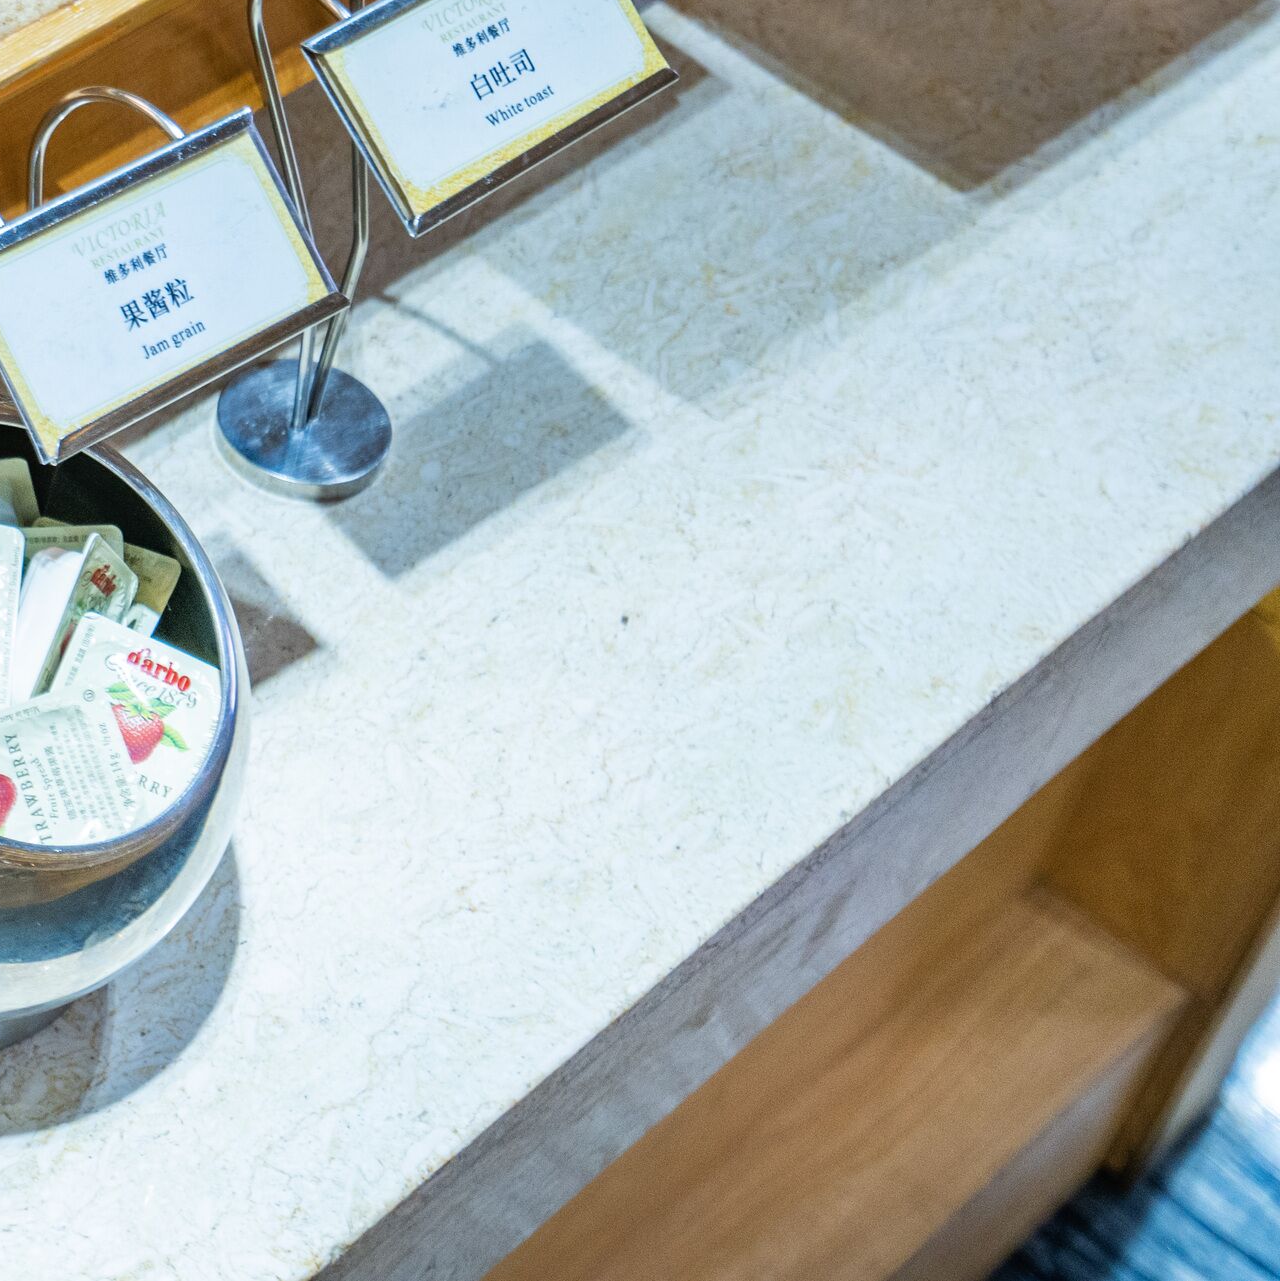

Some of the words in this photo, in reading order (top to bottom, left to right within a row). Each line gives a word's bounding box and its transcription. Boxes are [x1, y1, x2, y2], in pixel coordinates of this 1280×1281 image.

[440, 3, 507, 43] RESTAURANT
[453, 18, 509, 56] 维多利餐厅
[471, 49, 535, 100] 白吐司
[486, 103, 523, 125] White
[524, 86, 553, 107] toast
[71, 201, 168, 258] VICTORIA
[92, 227, 167, 267] RESTAURANT
[104, 244, 166, 284] 维多利餐厅
[121, 279, 194, 328] 果酱粒
[143, 340, 169, 359] Jam
[172, 322, 205, 348] grain
[158, 679, 200, 715] 1879
[29, 755, 53, 792] Spread
[43, 792, 61, 820] Fruit
